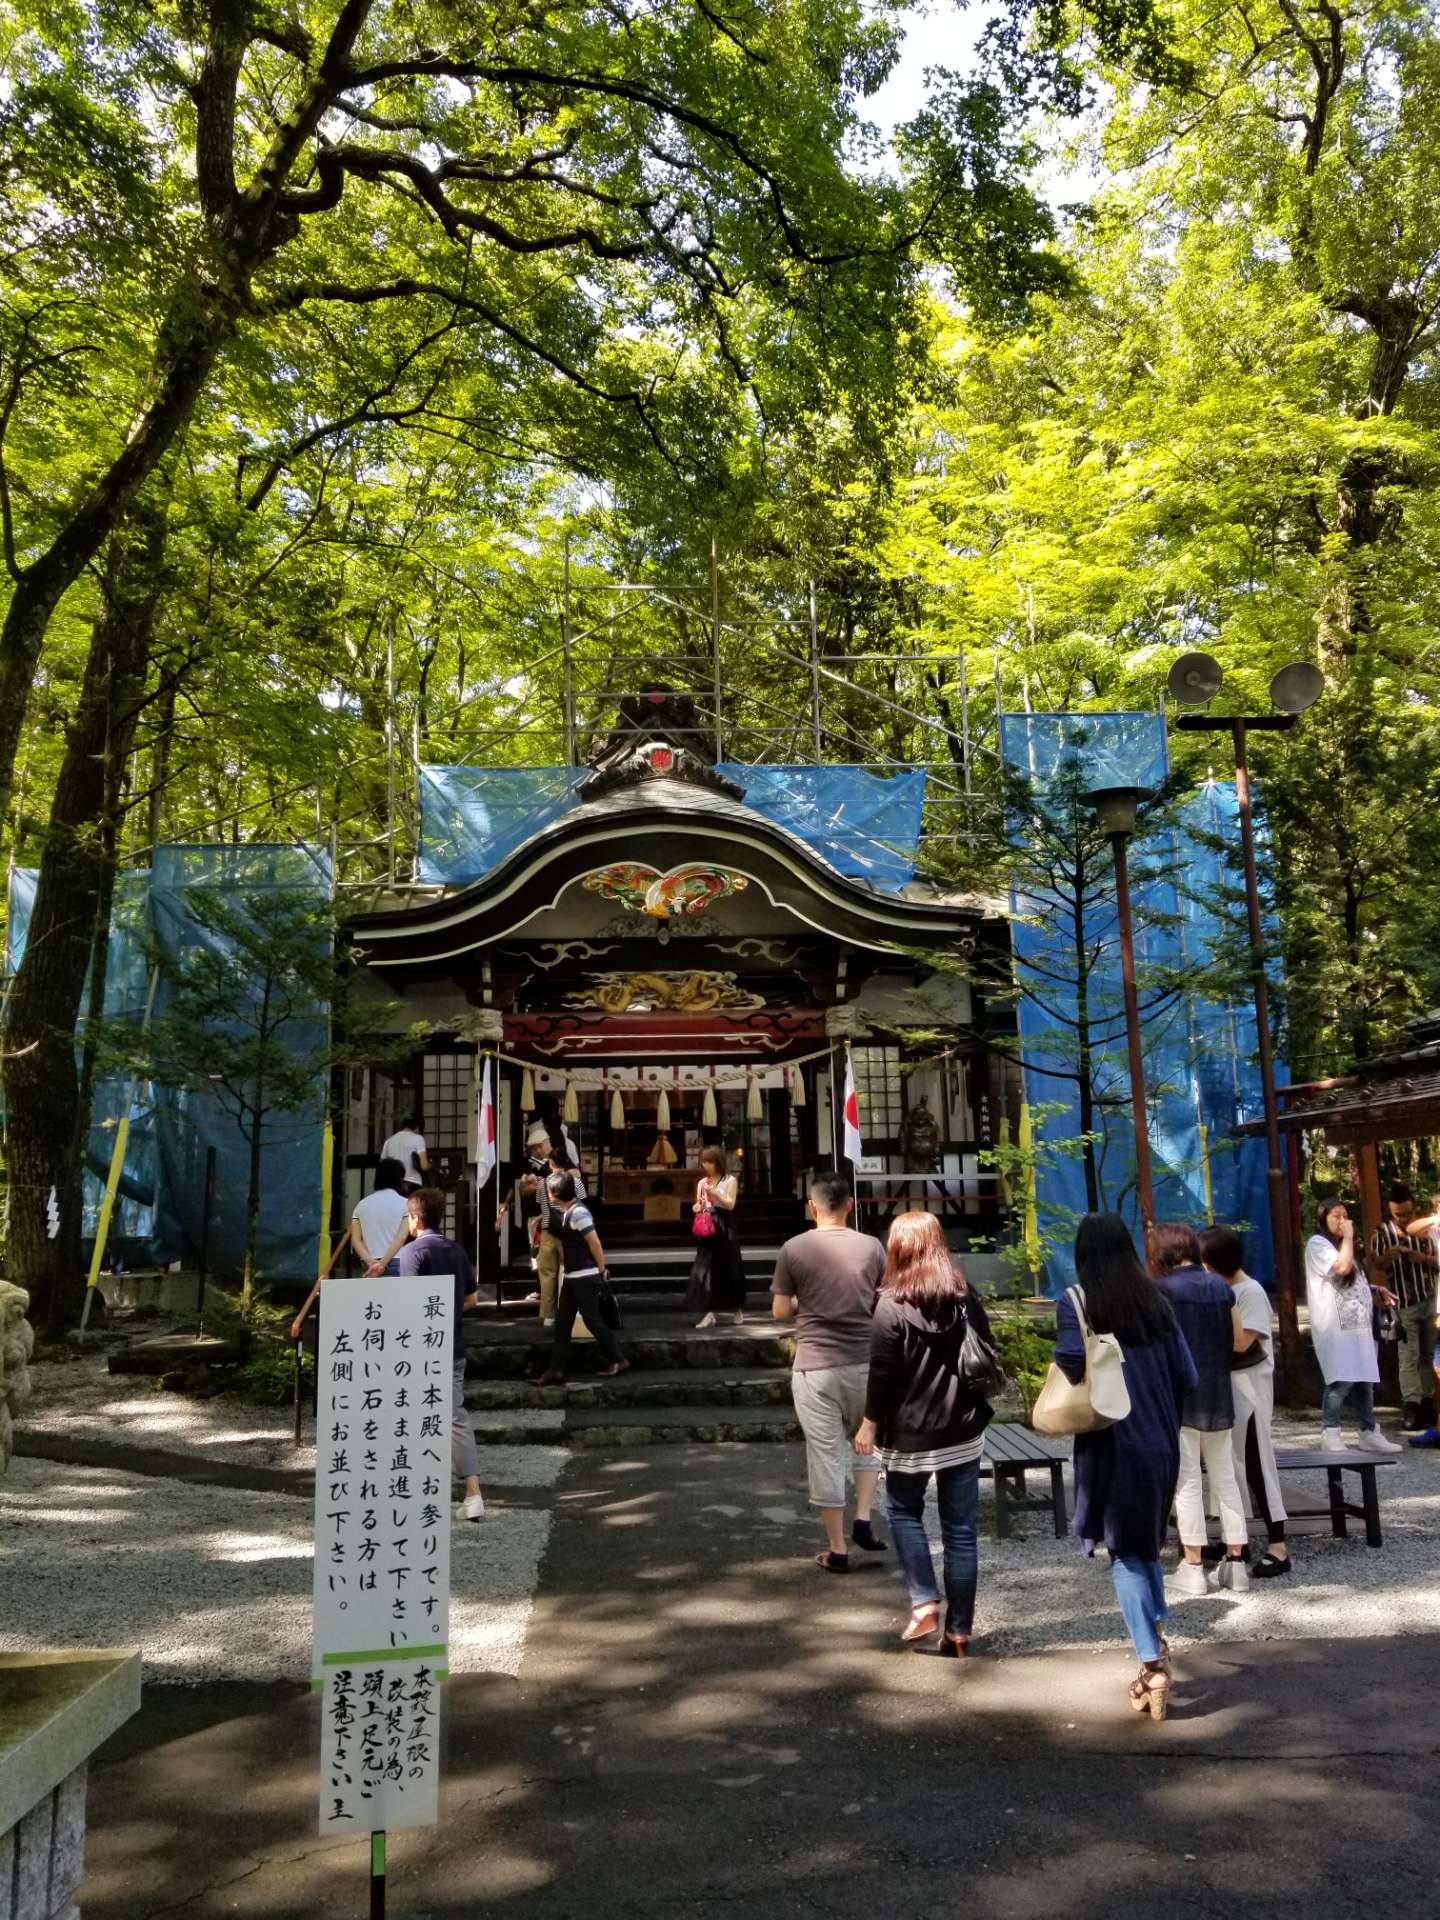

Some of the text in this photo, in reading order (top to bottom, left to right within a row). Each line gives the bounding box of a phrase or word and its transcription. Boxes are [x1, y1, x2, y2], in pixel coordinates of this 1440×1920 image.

[327, 1329, 353, 1610] 左側にお並び下さい。
[358, 1301, 385, 1590] お伺い石をされる方は
[388, 1329, 413, 1648] そのまま直進して下さい
[418, 1295, 445, 1633] 最初に本殿へお参りです。
[359, 1669, 386, 1799] 頭上足元ご
